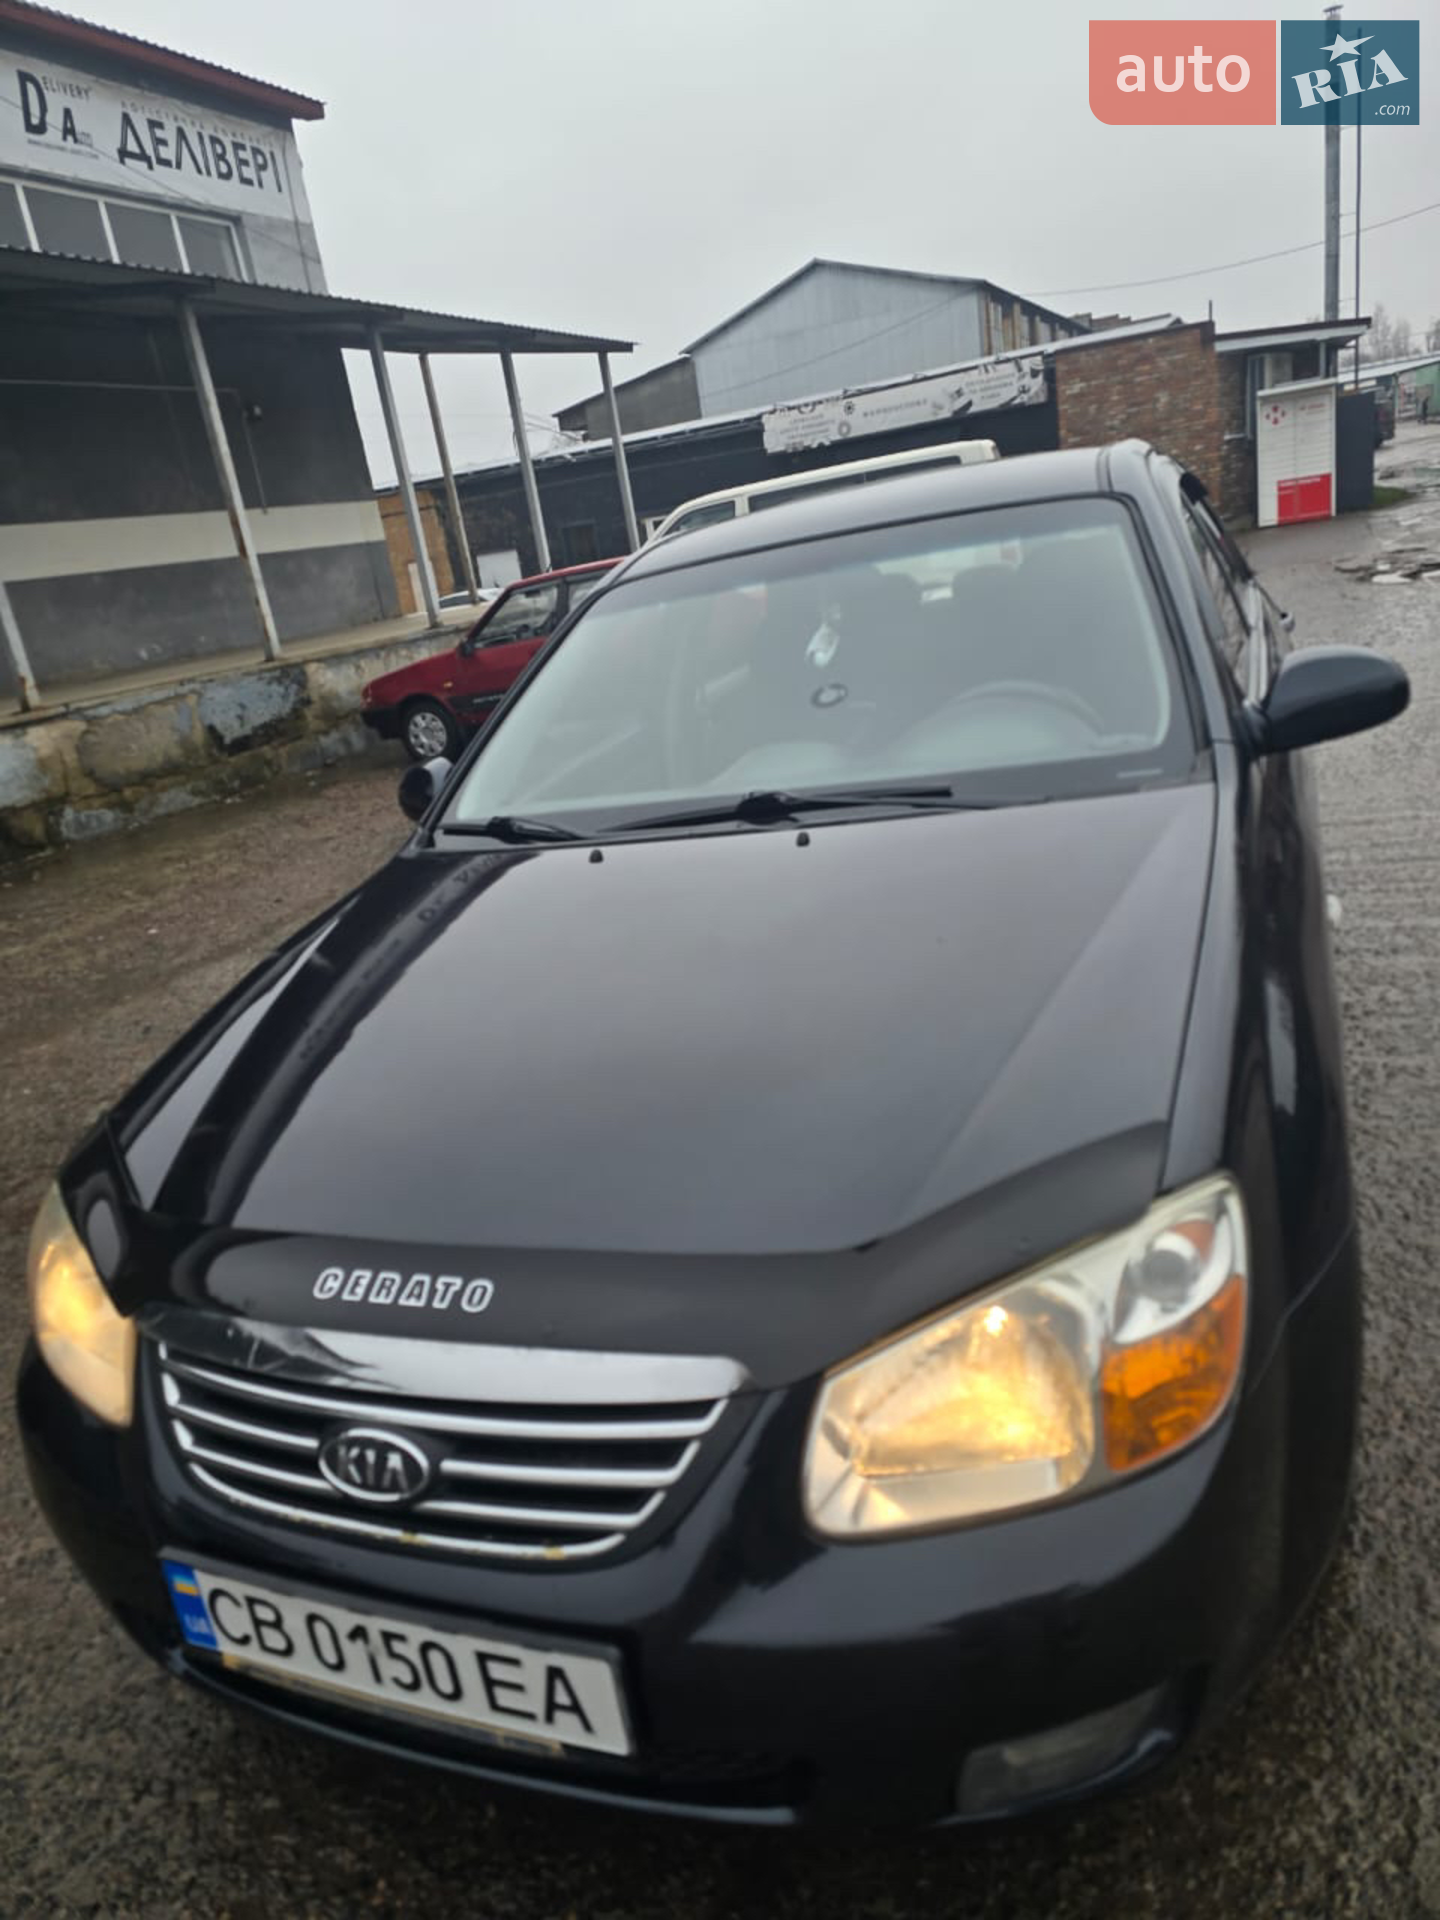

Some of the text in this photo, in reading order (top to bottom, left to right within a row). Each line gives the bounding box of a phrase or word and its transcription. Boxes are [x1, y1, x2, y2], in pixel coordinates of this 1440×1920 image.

[117, 111, 282, 193] ДЕЛІВЕРІ
[313, 1267, 494, 1313] CERATO
[337, 1445, 410, 1494] KIA
[208, 1588, 595, 1734] CB 0150 EA
